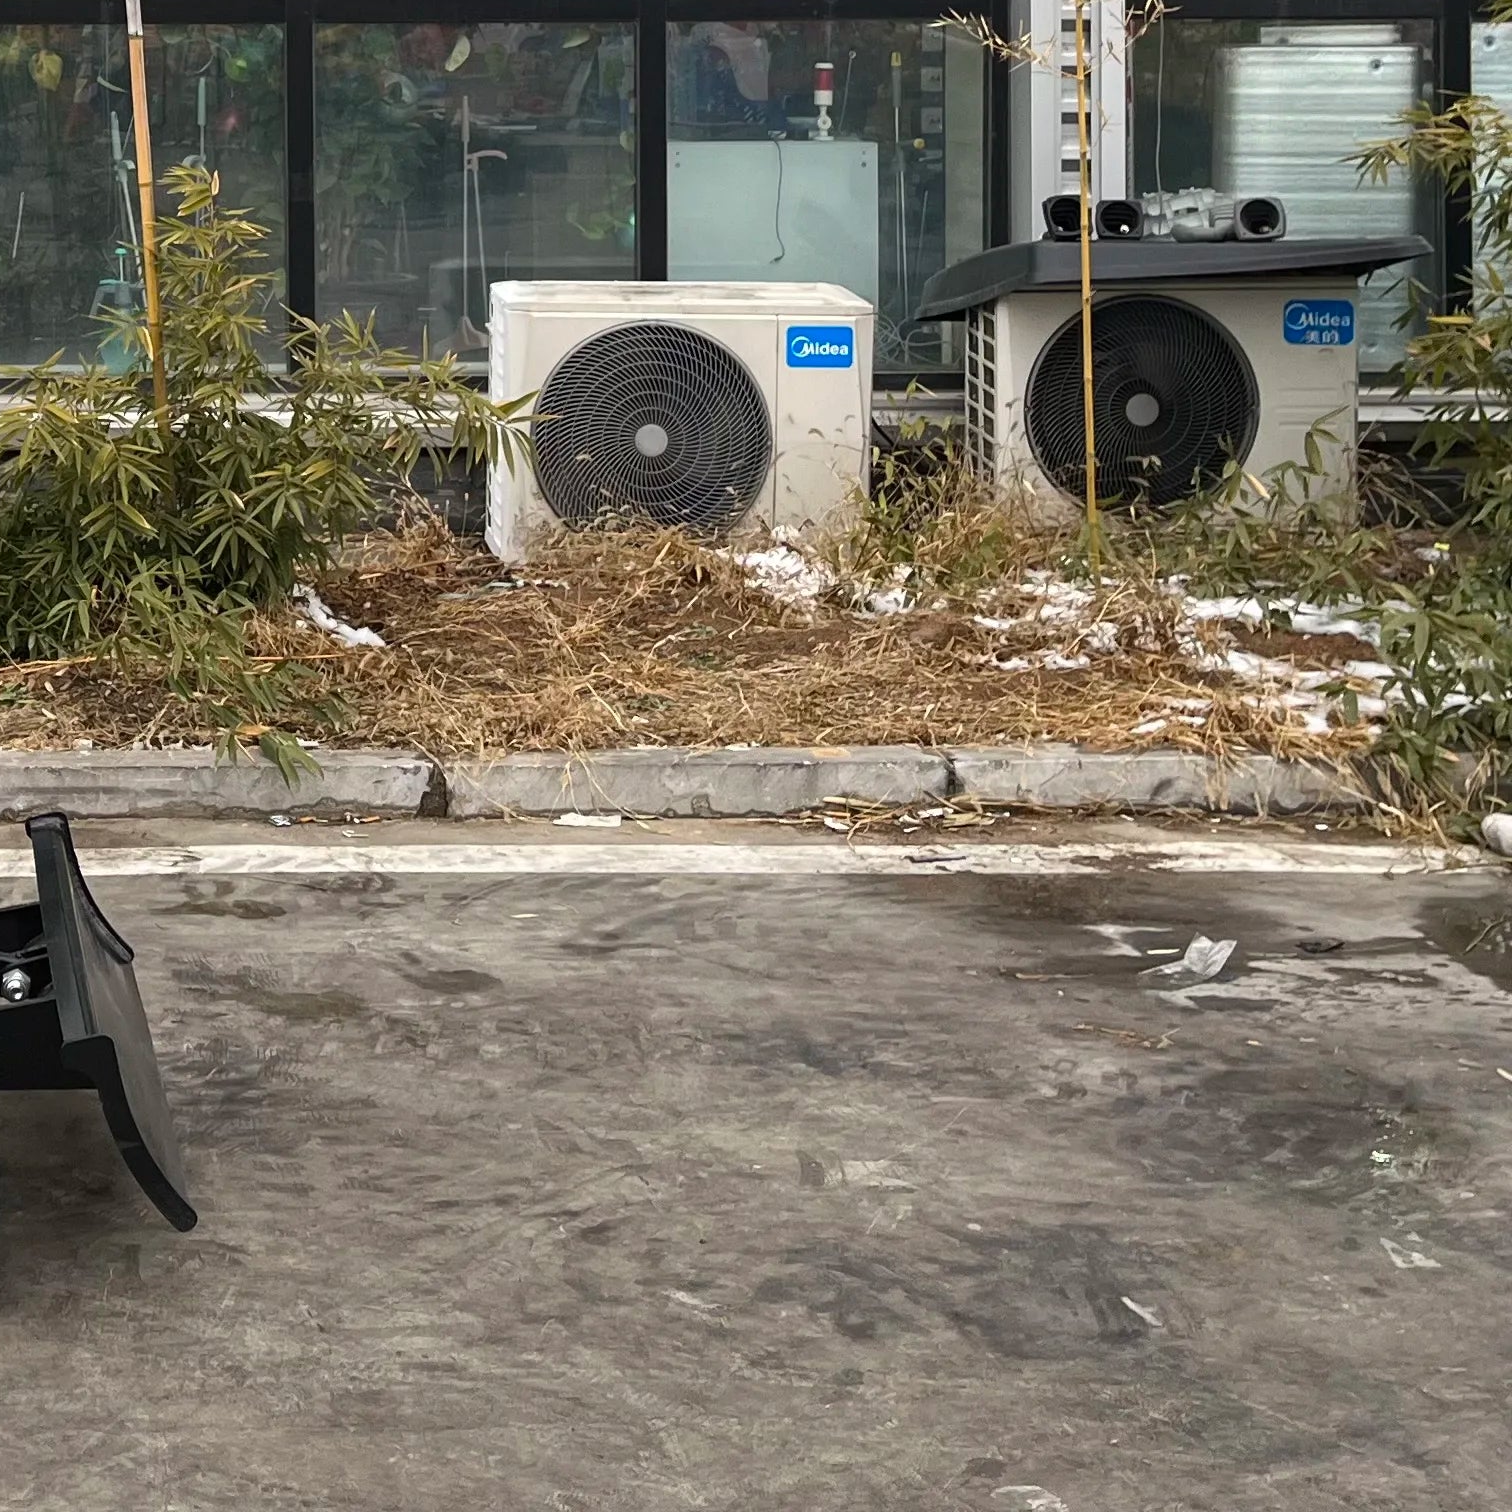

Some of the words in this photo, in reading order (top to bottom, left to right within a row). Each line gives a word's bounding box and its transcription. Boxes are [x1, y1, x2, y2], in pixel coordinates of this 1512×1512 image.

[1294, 309, 1350, 327] Midea
[1305, 330, 1339, 344] 美的
[800, 340, 849, 356] Midea
